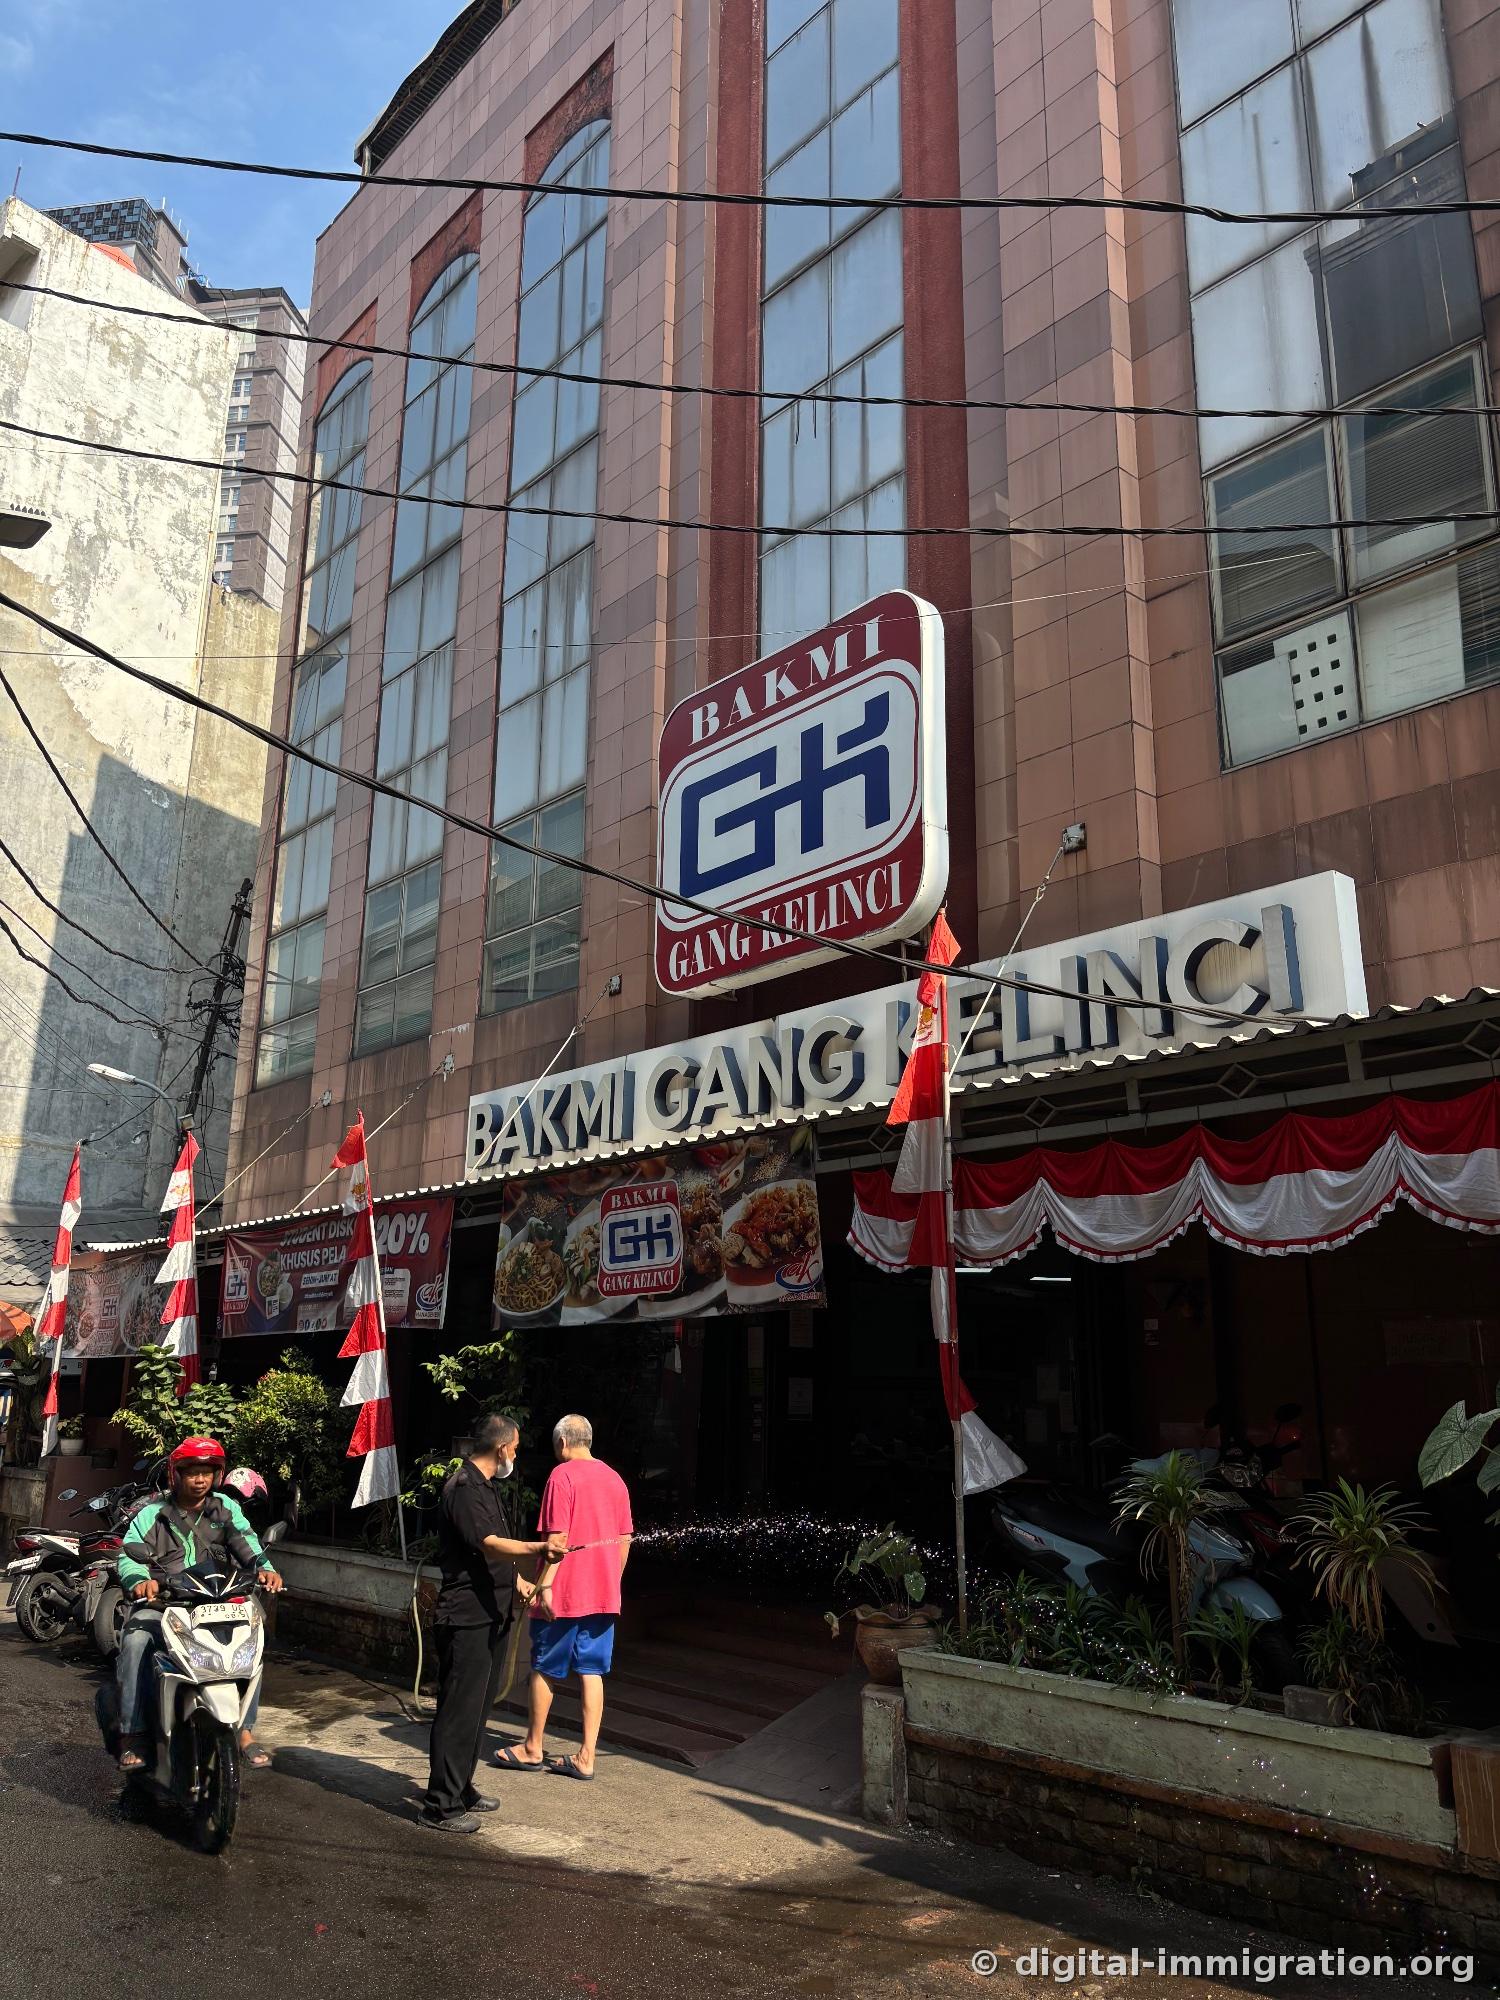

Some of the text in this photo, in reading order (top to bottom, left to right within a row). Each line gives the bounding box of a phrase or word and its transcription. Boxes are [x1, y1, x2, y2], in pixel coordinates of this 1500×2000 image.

[688, 614, 885, 746] BAKMI
[679, 690, 891, 898] GK
[668, 861, 904, 982] GANG KELINCI
[467, 903, 1304, 1169] BAKMI GANG KELINCI
[611, 1186, 667, 1209] BAKMI
[280, 1244, 346, 1272] KHUSUS PELA
[328, 1216, 354, 1240] DISK
[375, 1211, 430, 1256] 20%
[608, 1213, 674, 1264] GK
[602, 1268, 675, 1292] GANG KELINCI
